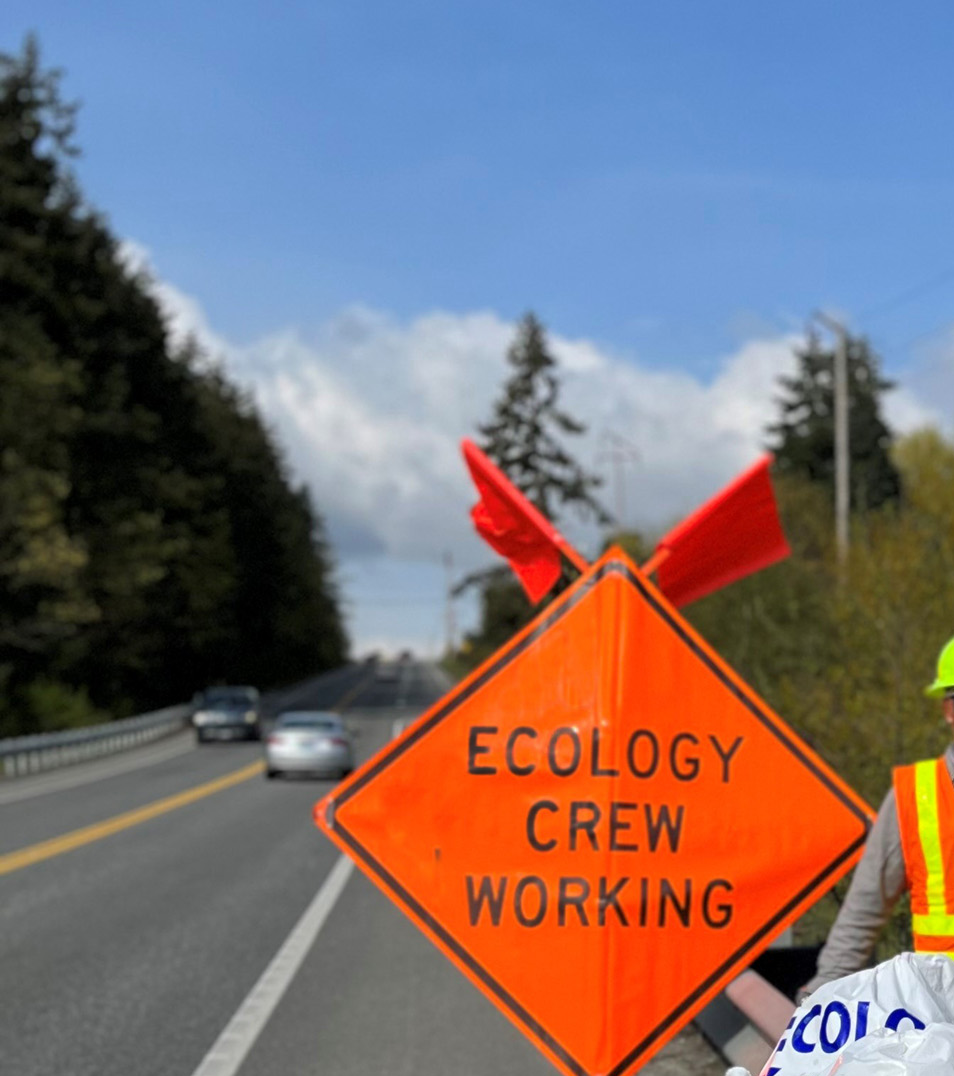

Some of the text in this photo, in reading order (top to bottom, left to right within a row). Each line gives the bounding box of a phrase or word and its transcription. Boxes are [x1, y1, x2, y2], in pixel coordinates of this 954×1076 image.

[467, 726, 743, 783] ECOLOGY
[526, 800, 685, 853] CREW
[466, 875, 734, 929] WORKING
